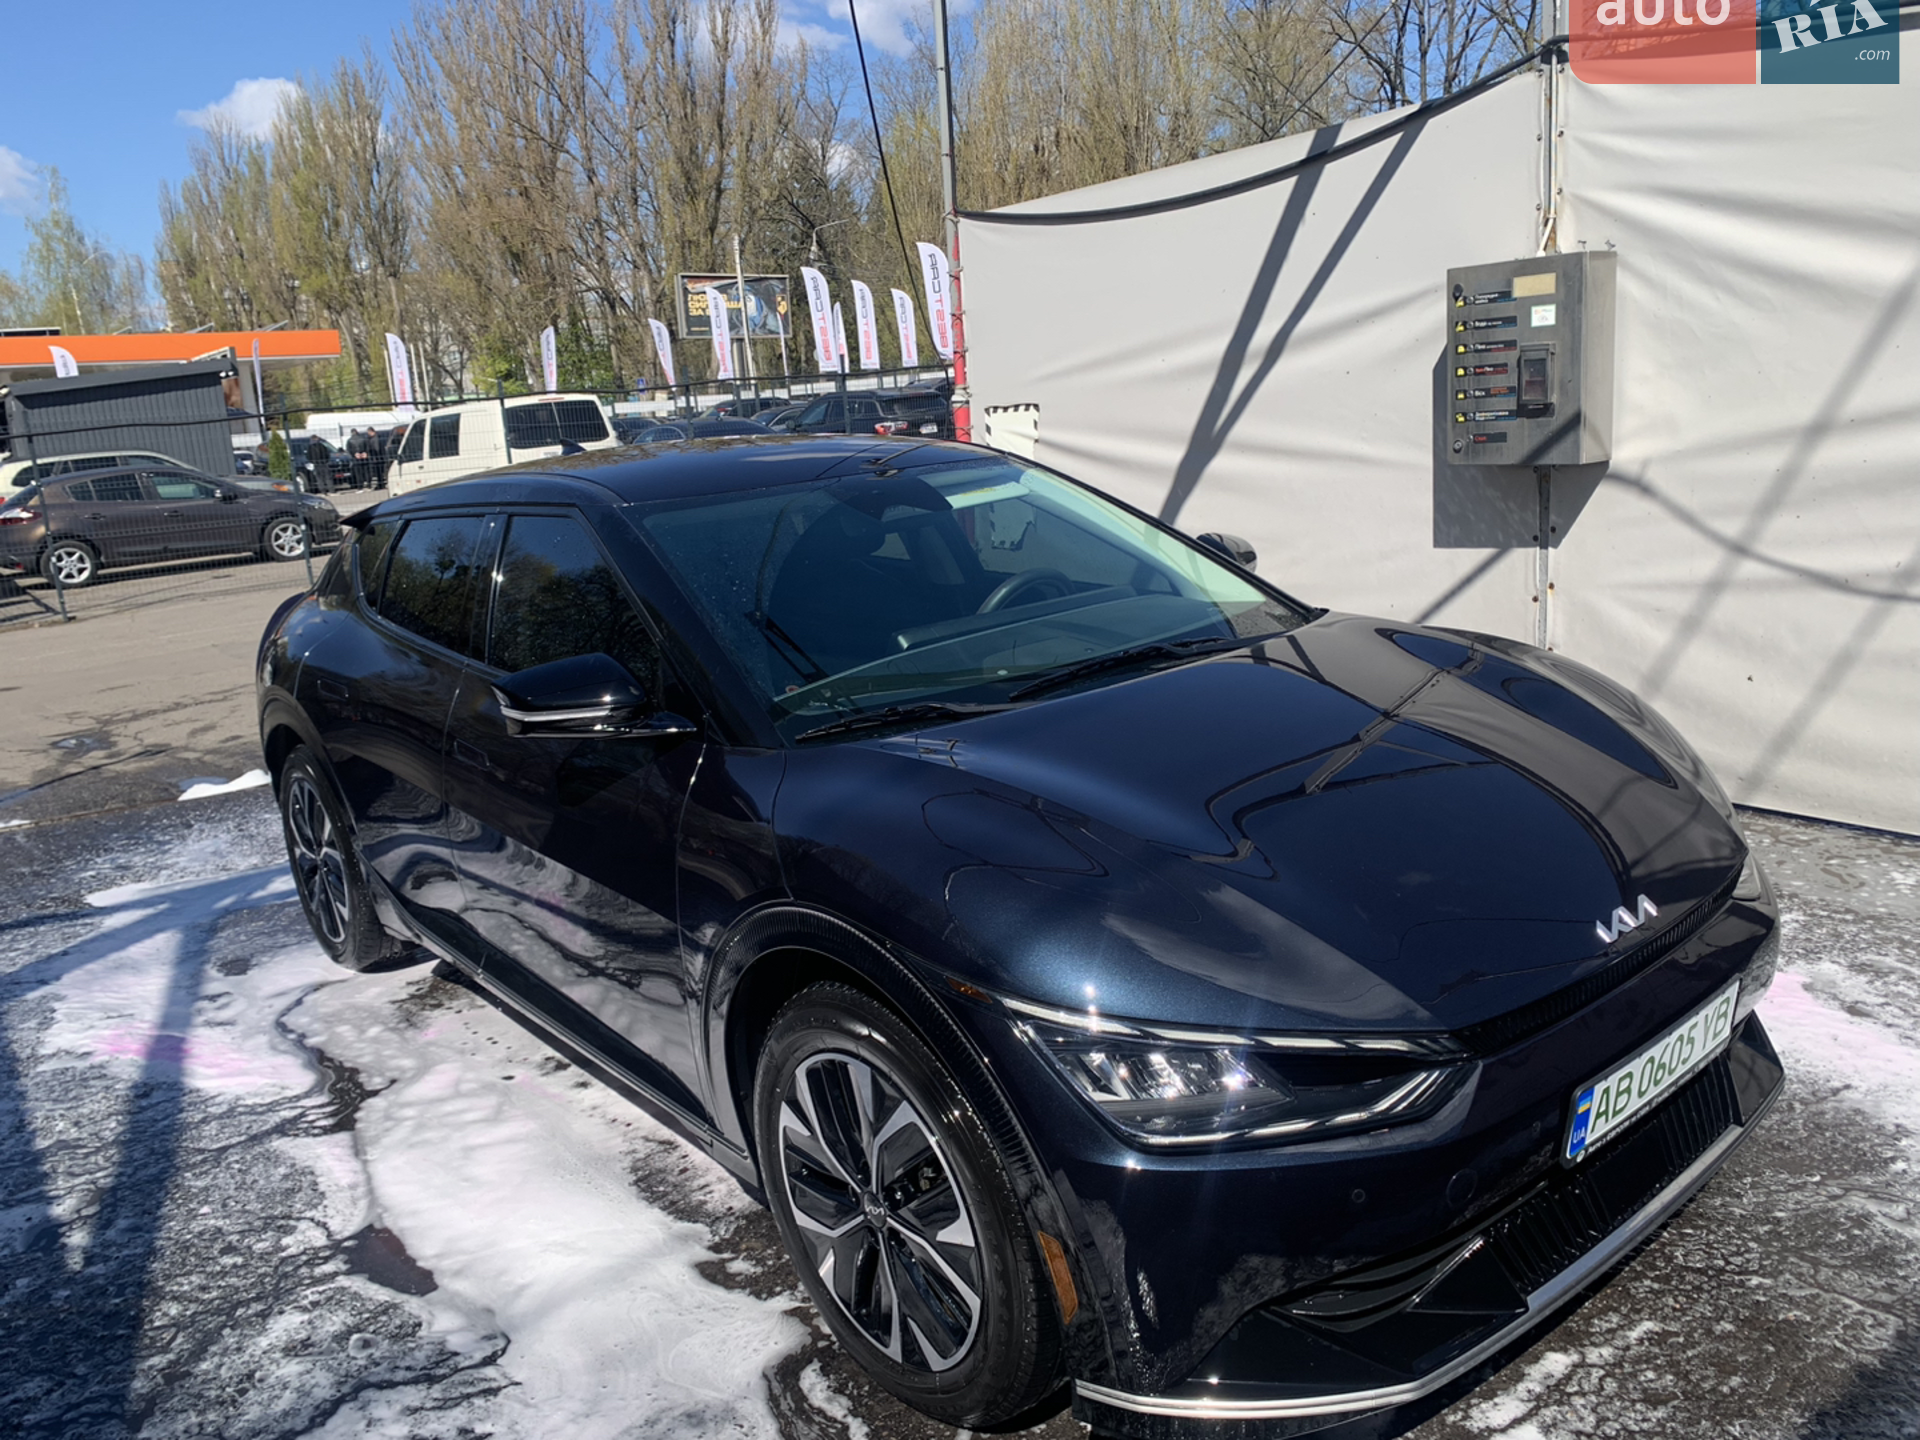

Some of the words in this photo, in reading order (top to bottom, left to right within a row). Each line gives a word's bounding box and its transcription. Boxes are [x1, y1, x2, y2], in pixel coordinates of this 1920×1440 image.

[1591, 1070, 1634, 1134] AB
[1637, 1020, 1699, 1099] 0605
[1702, 996, 1731, 1050] YB
[1573, 1126, 1586, 1144] UA
